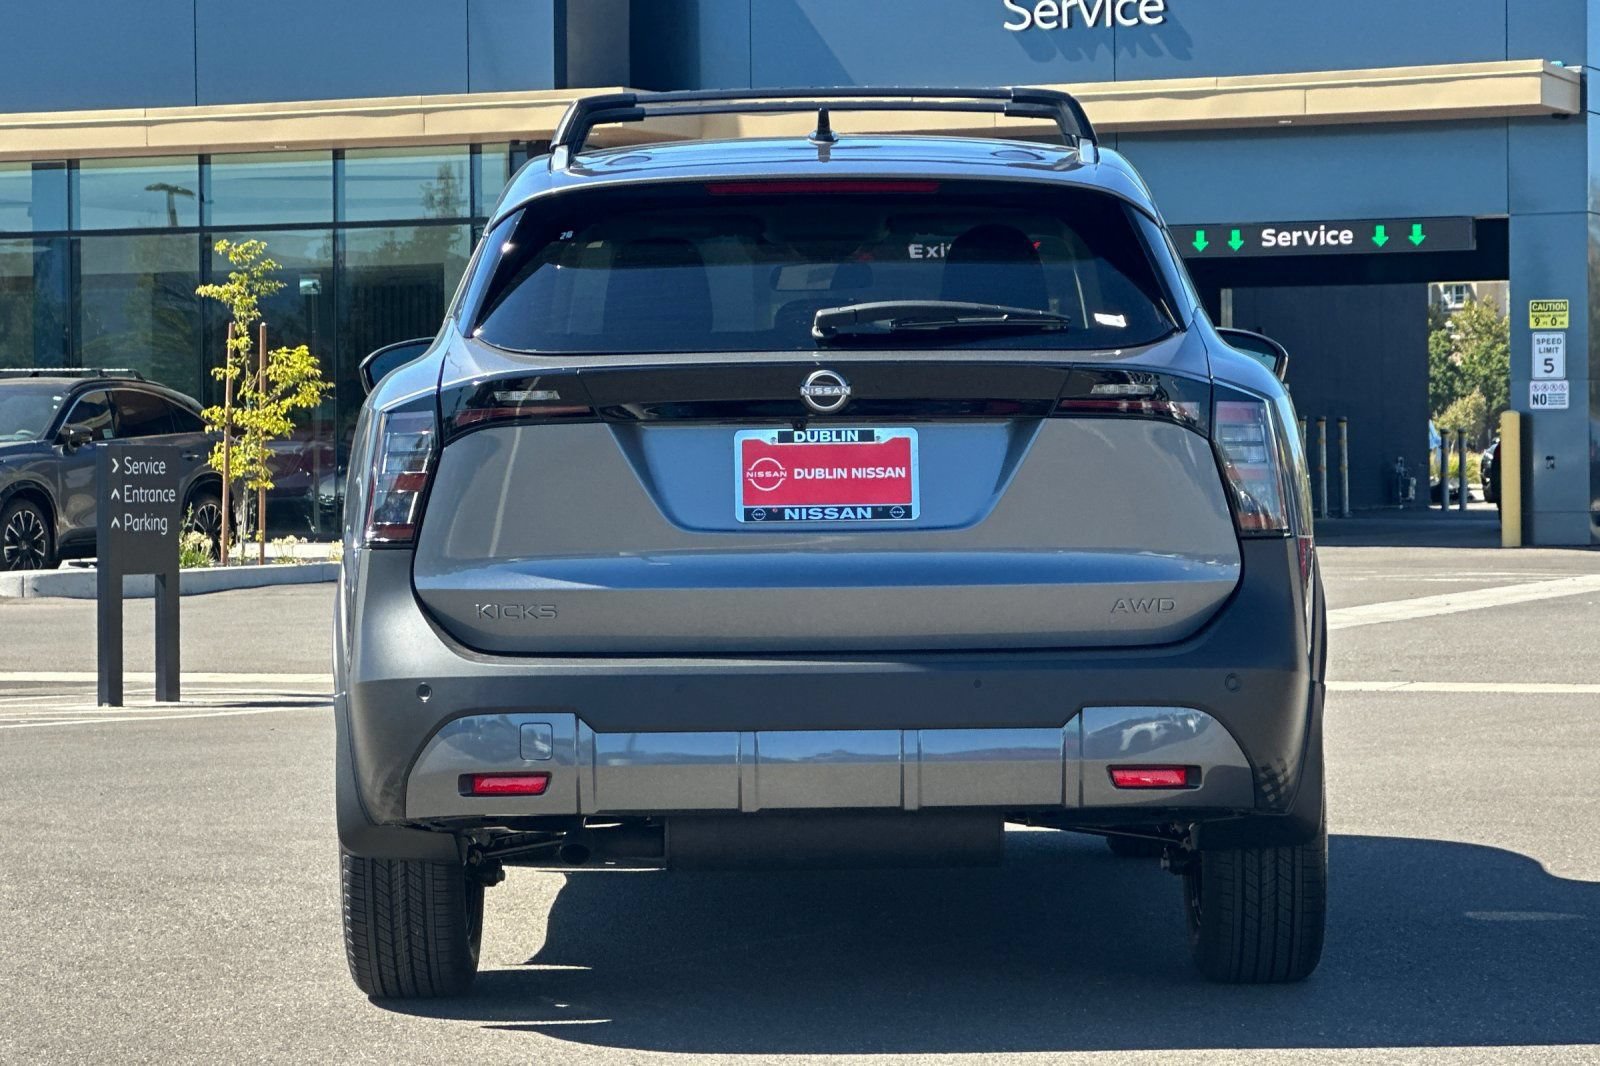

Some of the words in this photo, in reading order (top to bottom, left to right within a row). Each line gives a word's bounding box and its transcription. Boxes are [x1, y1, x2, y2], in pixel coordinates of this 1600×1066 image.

[1003, 0, 1165, 31] Service
[1261, 225, 1354, 247] Service
[1532, 302, 1567, 311] CAUTION
[1534, 317, 1541, 326] 9
[1543, 358, 1555, 374] 5
[801, 387, 850, 395] NISSAN
[1532, 393, 1547, 405] NO
[793, 430, 859, 443] DUBLIN
[124, 456, 166, 475] Service
[793, 468, 848, 480] DUBLIN
[851, 467, 906, 479] NISSAN
[124, 484, 176, 503] Entrance
[784, 507, 872, 520] NISSAN
[124, 513, 168, 536] Parking
[475, 604, 558, 619] KICKS
[1110, 597, 1176, 614] AWD
